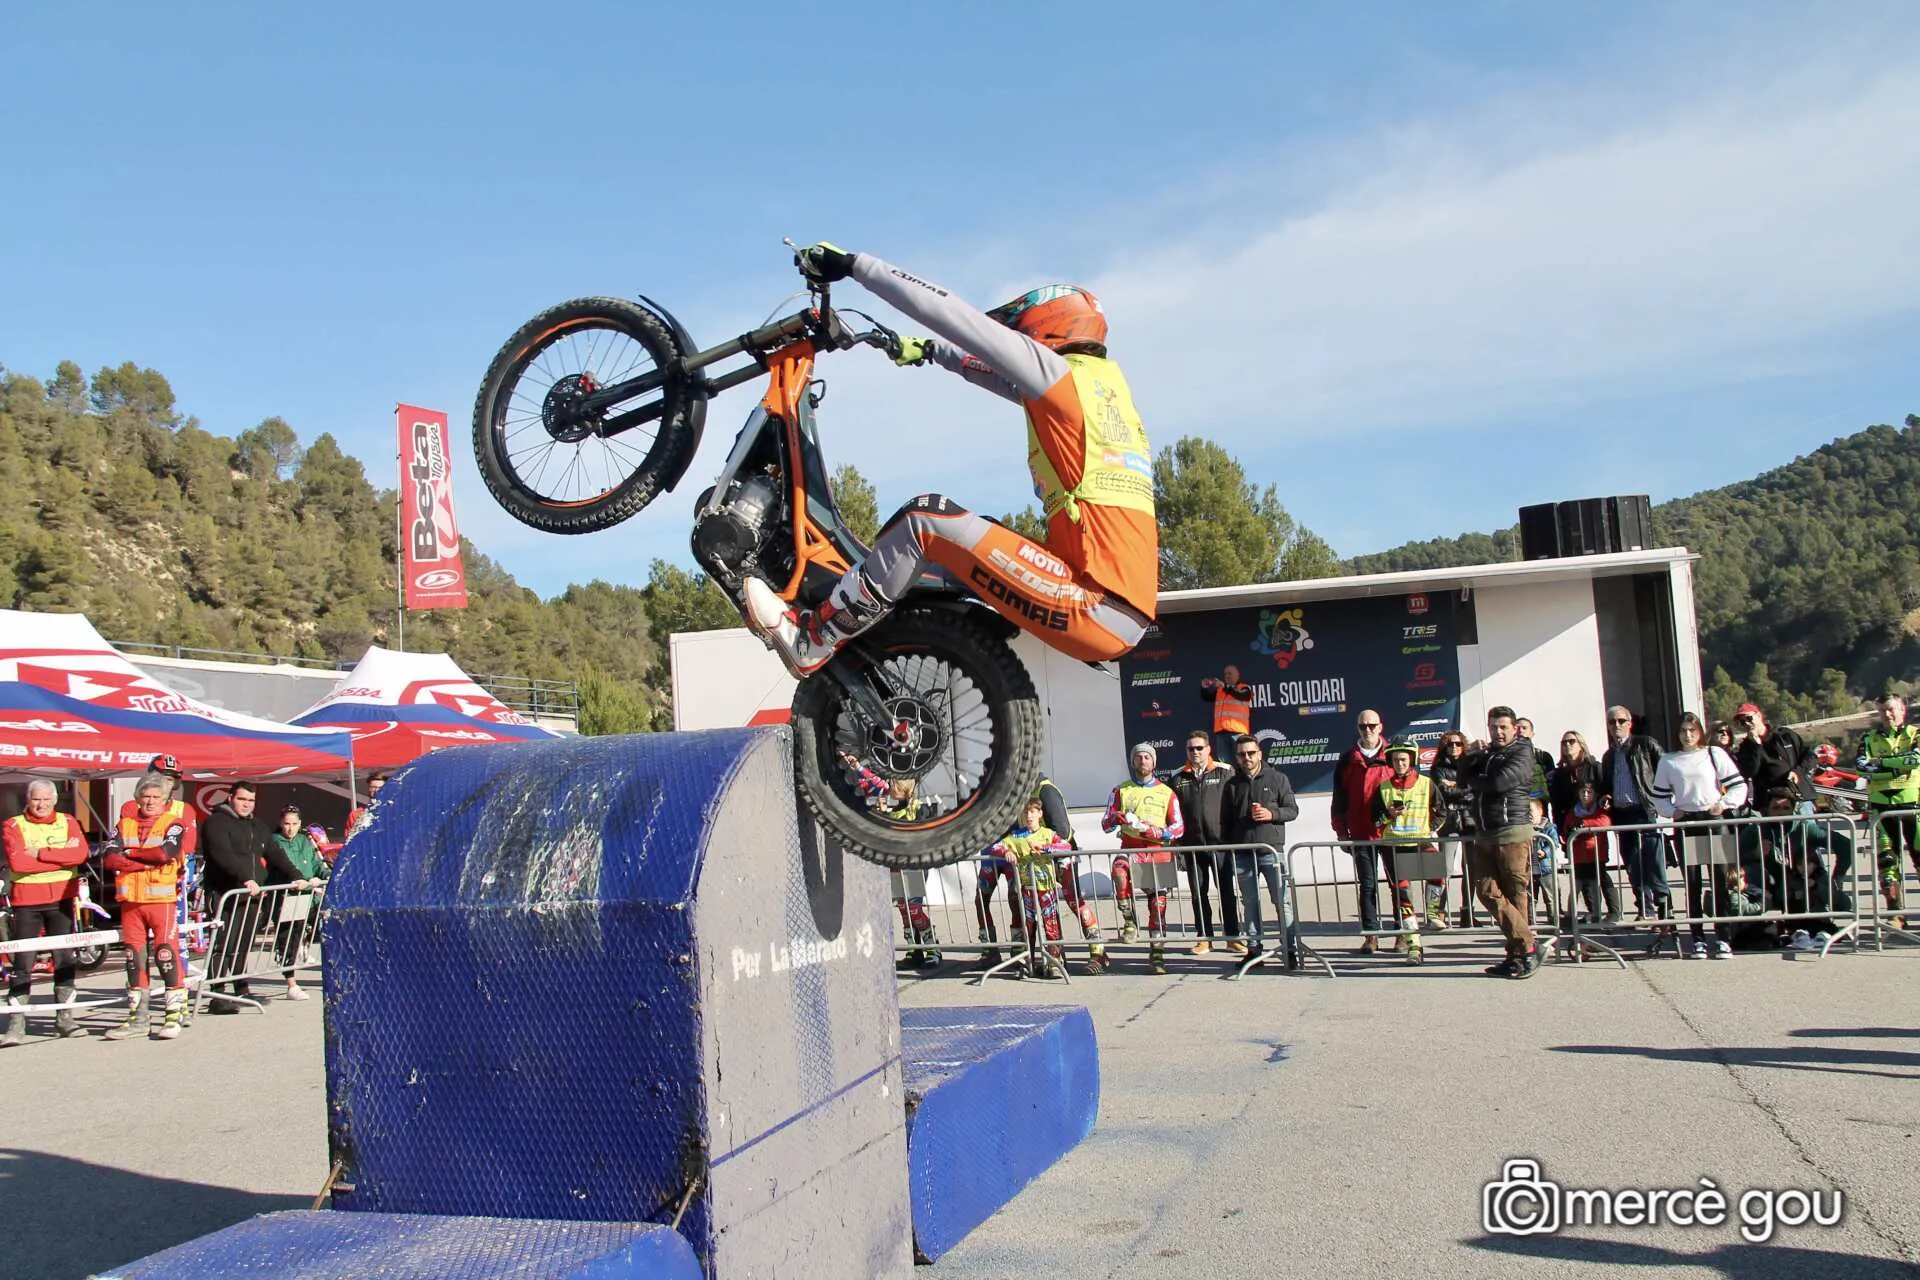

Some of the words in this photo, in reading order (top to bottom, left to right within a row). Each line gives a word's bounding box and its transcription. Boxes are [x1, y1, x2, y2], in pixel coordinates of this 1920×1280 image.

[412, 422, 440, 561] Beta
[1018, 544, 1067, 577] MOTU
[970, 565, 1070, 632] COMAS
[1279, 677, 1346, 706] SOLIDARI
[1268, 744, 1329, 757] CIRCUIT
